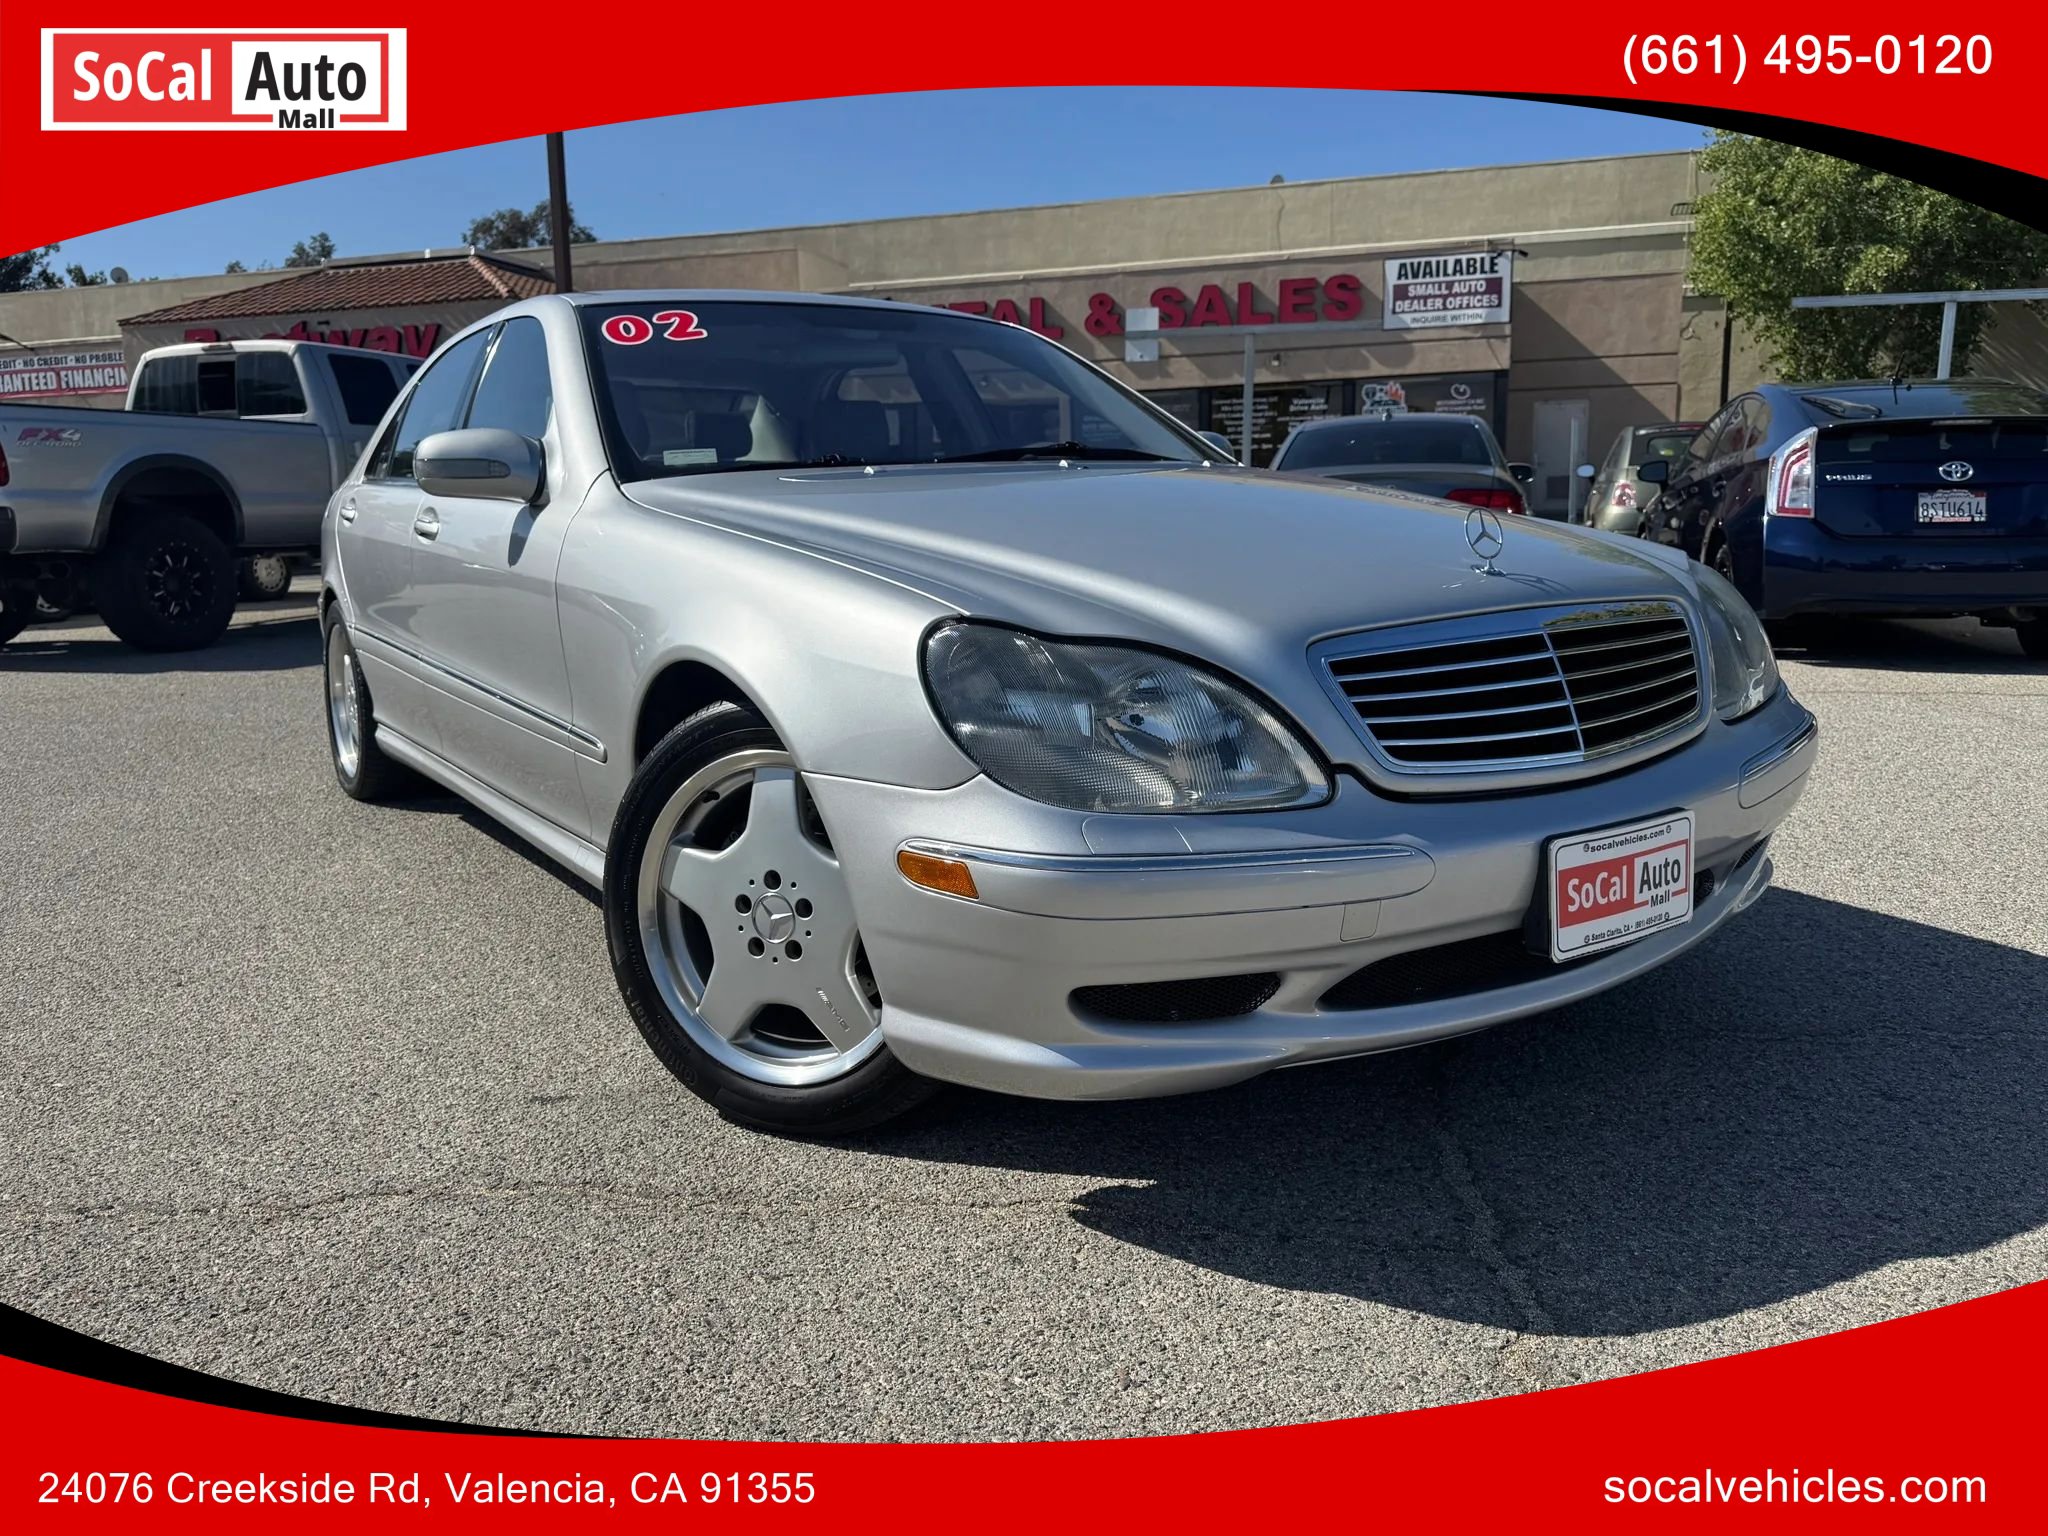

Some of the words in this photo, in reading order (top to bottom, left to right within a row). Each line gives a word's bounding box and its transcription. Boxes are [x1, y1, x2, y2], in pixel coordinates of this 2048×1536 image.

[1397, 256, 1499, 280] AVAILABLE
[1407, 283, 1449, 297] SMALL
[1451, 280, 1487, 294] AUTO
[1084, 293, 1124, 336] &
[1150, 274, 1364, 332] SALES
[1395, 299, 1443, 313] DEALER
[1446, 294, 1498, 309] OFFICES
[601, 310, 708, 346] 02
[23, 358, 35, 368] NO
[37, 355, 69, 367] CREDIT
[75, 354, 88, 364] NO
[17, 427, 81, 441] FX4
[1921, 501, 1984, 518] 8STU614
[1590, 829, 1665, 853] socalvehicles.com
[1567, 865, 1628, 913] SoCal
[1638, 857, 1681, 895] Auto
[1650, 889, 1671, 908] Mall
[1591, 931, 1606, 941] Santa
